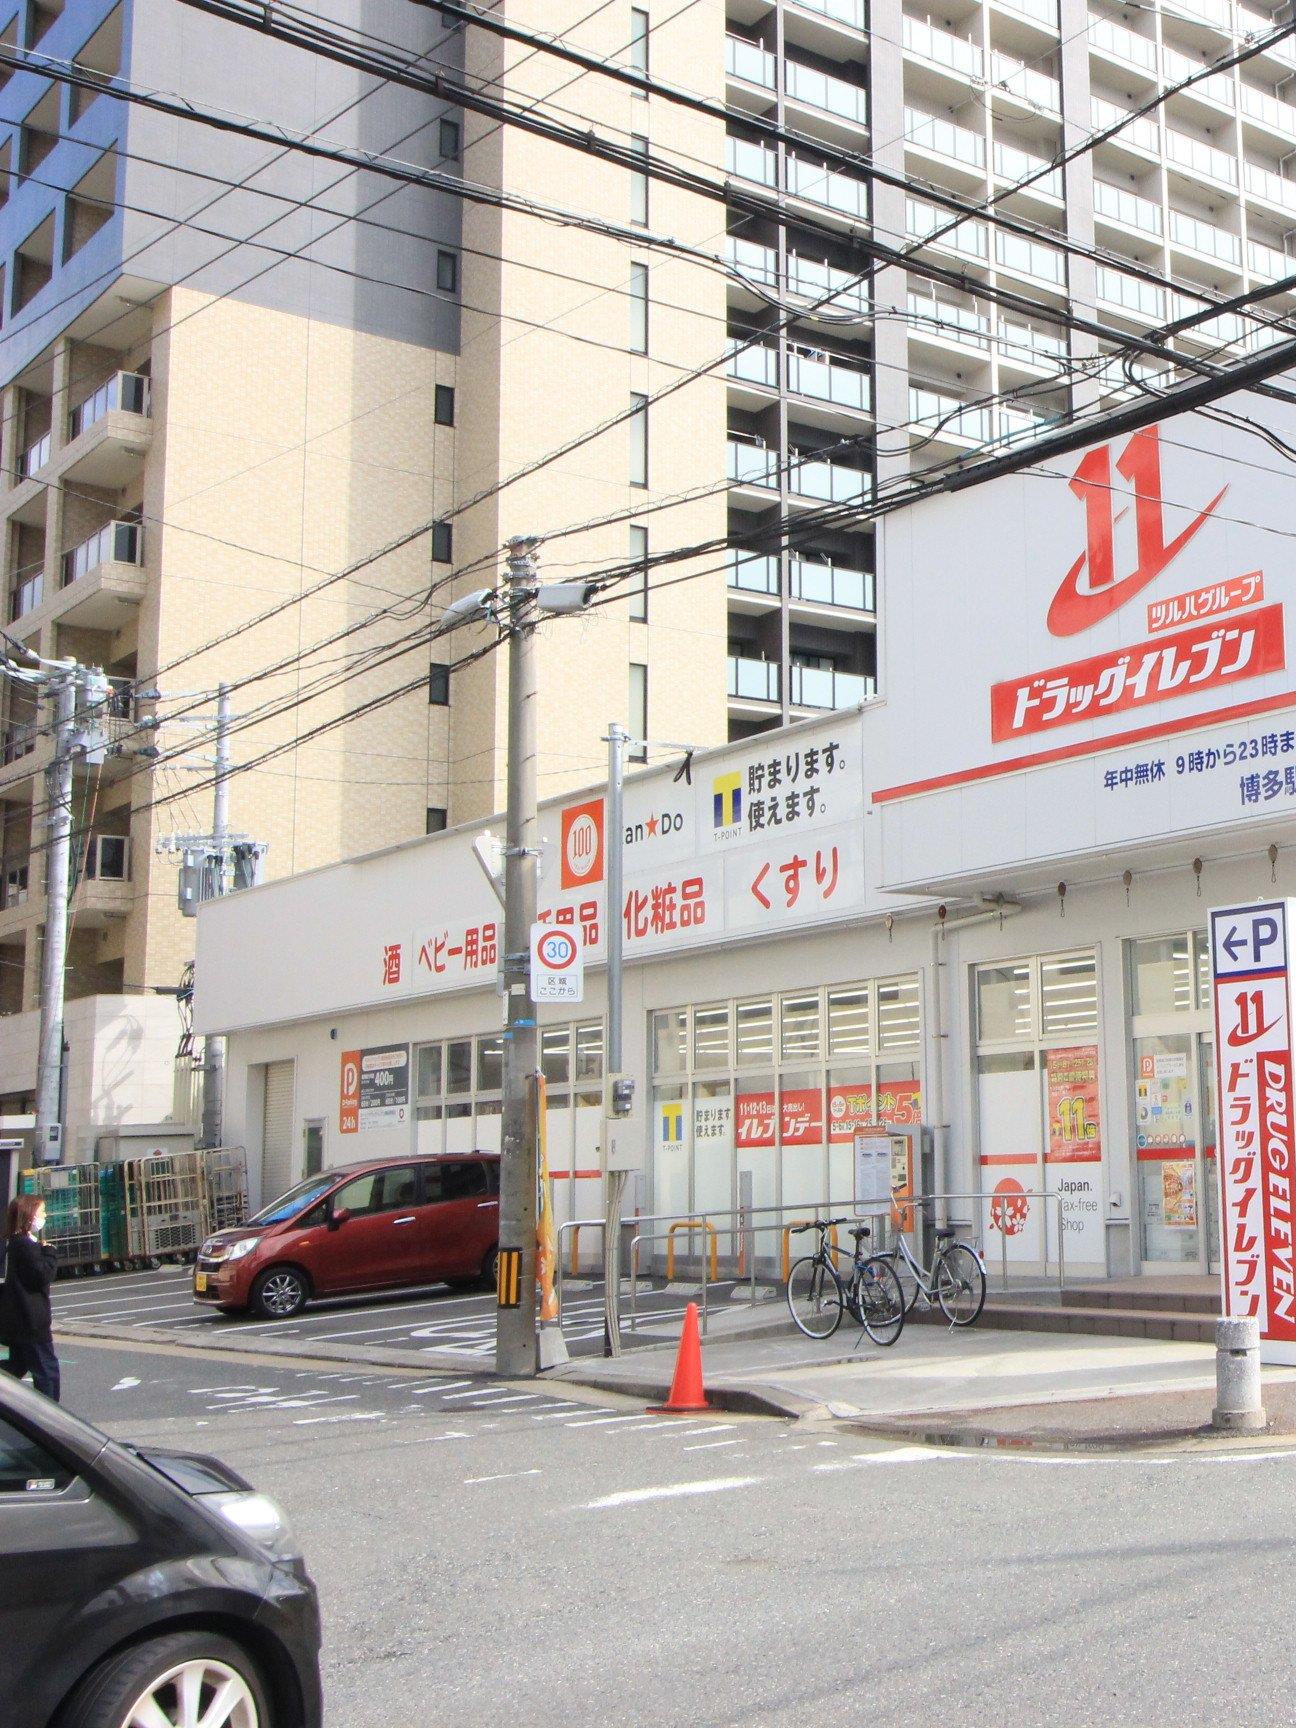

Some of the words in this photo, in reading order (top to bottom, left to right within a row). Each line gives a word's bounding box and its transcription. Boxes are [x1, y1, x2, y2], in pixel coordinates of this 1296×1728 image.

[1151, 576, 1261, 628] ツルハグループ
[1012, 628, 1255, 730] ドラッグイレブン
[748, 742, 845, 795] 貯まります。
[1104, 760, 1166, 791] 年中無休
[748, 786, 826, 832] 使えます。
[573, 824, 592, 860] 100
[714, 828, 742, 841] T-POINT
[383, 943, 401, 985] 酒
[418, 922, 496, 973] ベビー用品
[623, 876, 705, 939] 化粧品
[751, 847, 838, 909] くすり
[546, 941, 568, 958] 30
[1252, 917, 1278, 962] P
[539, 987, 576, 996] ここから
[343, 1117, 356, 1130] 24h
[1058, 1179, 1093, 1194] Japan.
[1062, 1198, 1098, 1211] ax-free
[1228, 1059, 1260, 1317] ドラッグイレブン
